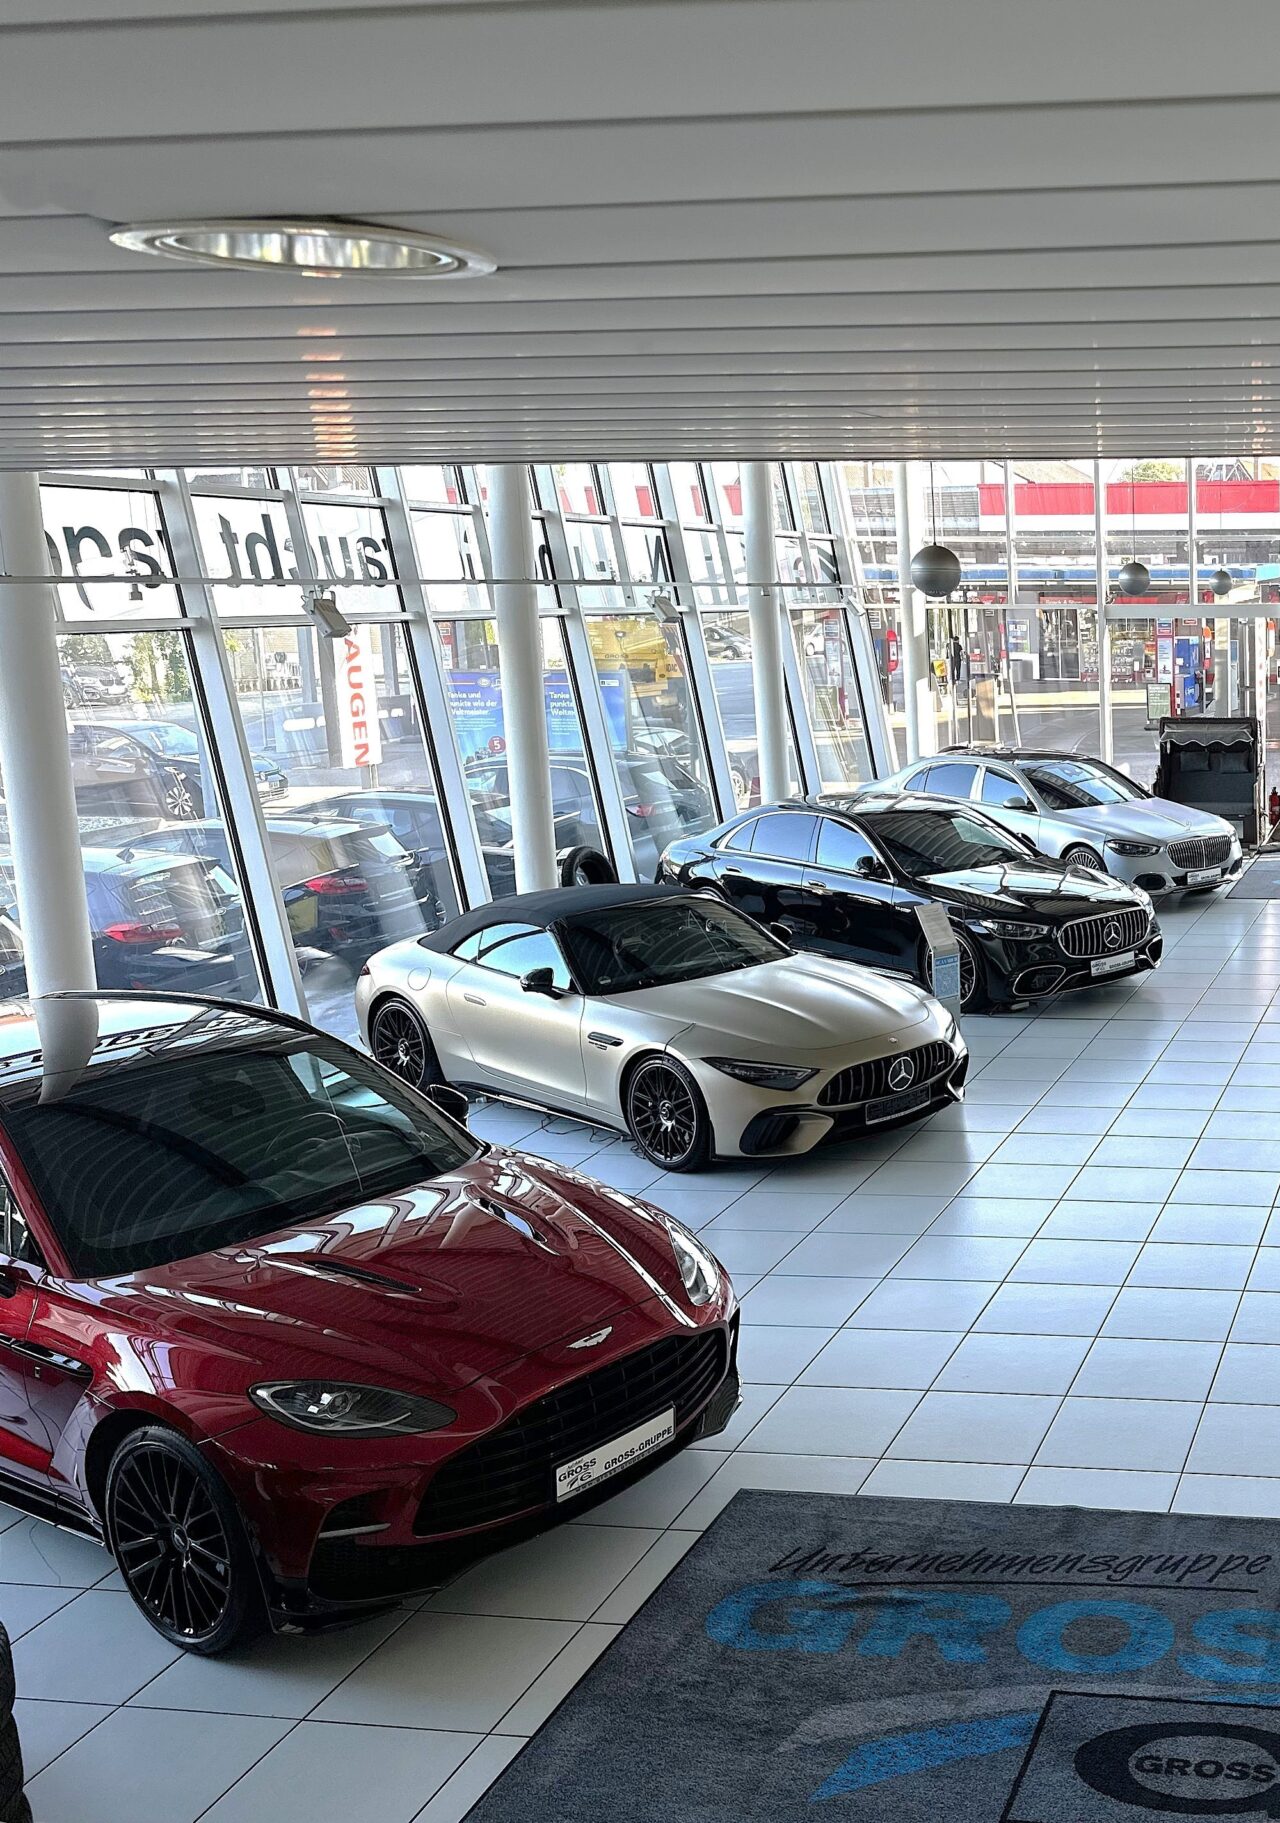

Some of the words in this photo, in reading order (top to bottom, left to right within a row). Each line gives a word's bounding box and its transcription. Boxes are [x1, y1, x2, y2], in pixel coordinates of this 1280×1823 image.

[343, 625, 370, 767] AUGEN
[604, 1425, 673, 1471] GROSS-GRUPPE
[558, 1457, 597, 1482] GROSS
[768, 1546, 1273, 1584] Unternehmensgruppe
[1134, 1754, 1277, 1784] GROSS
